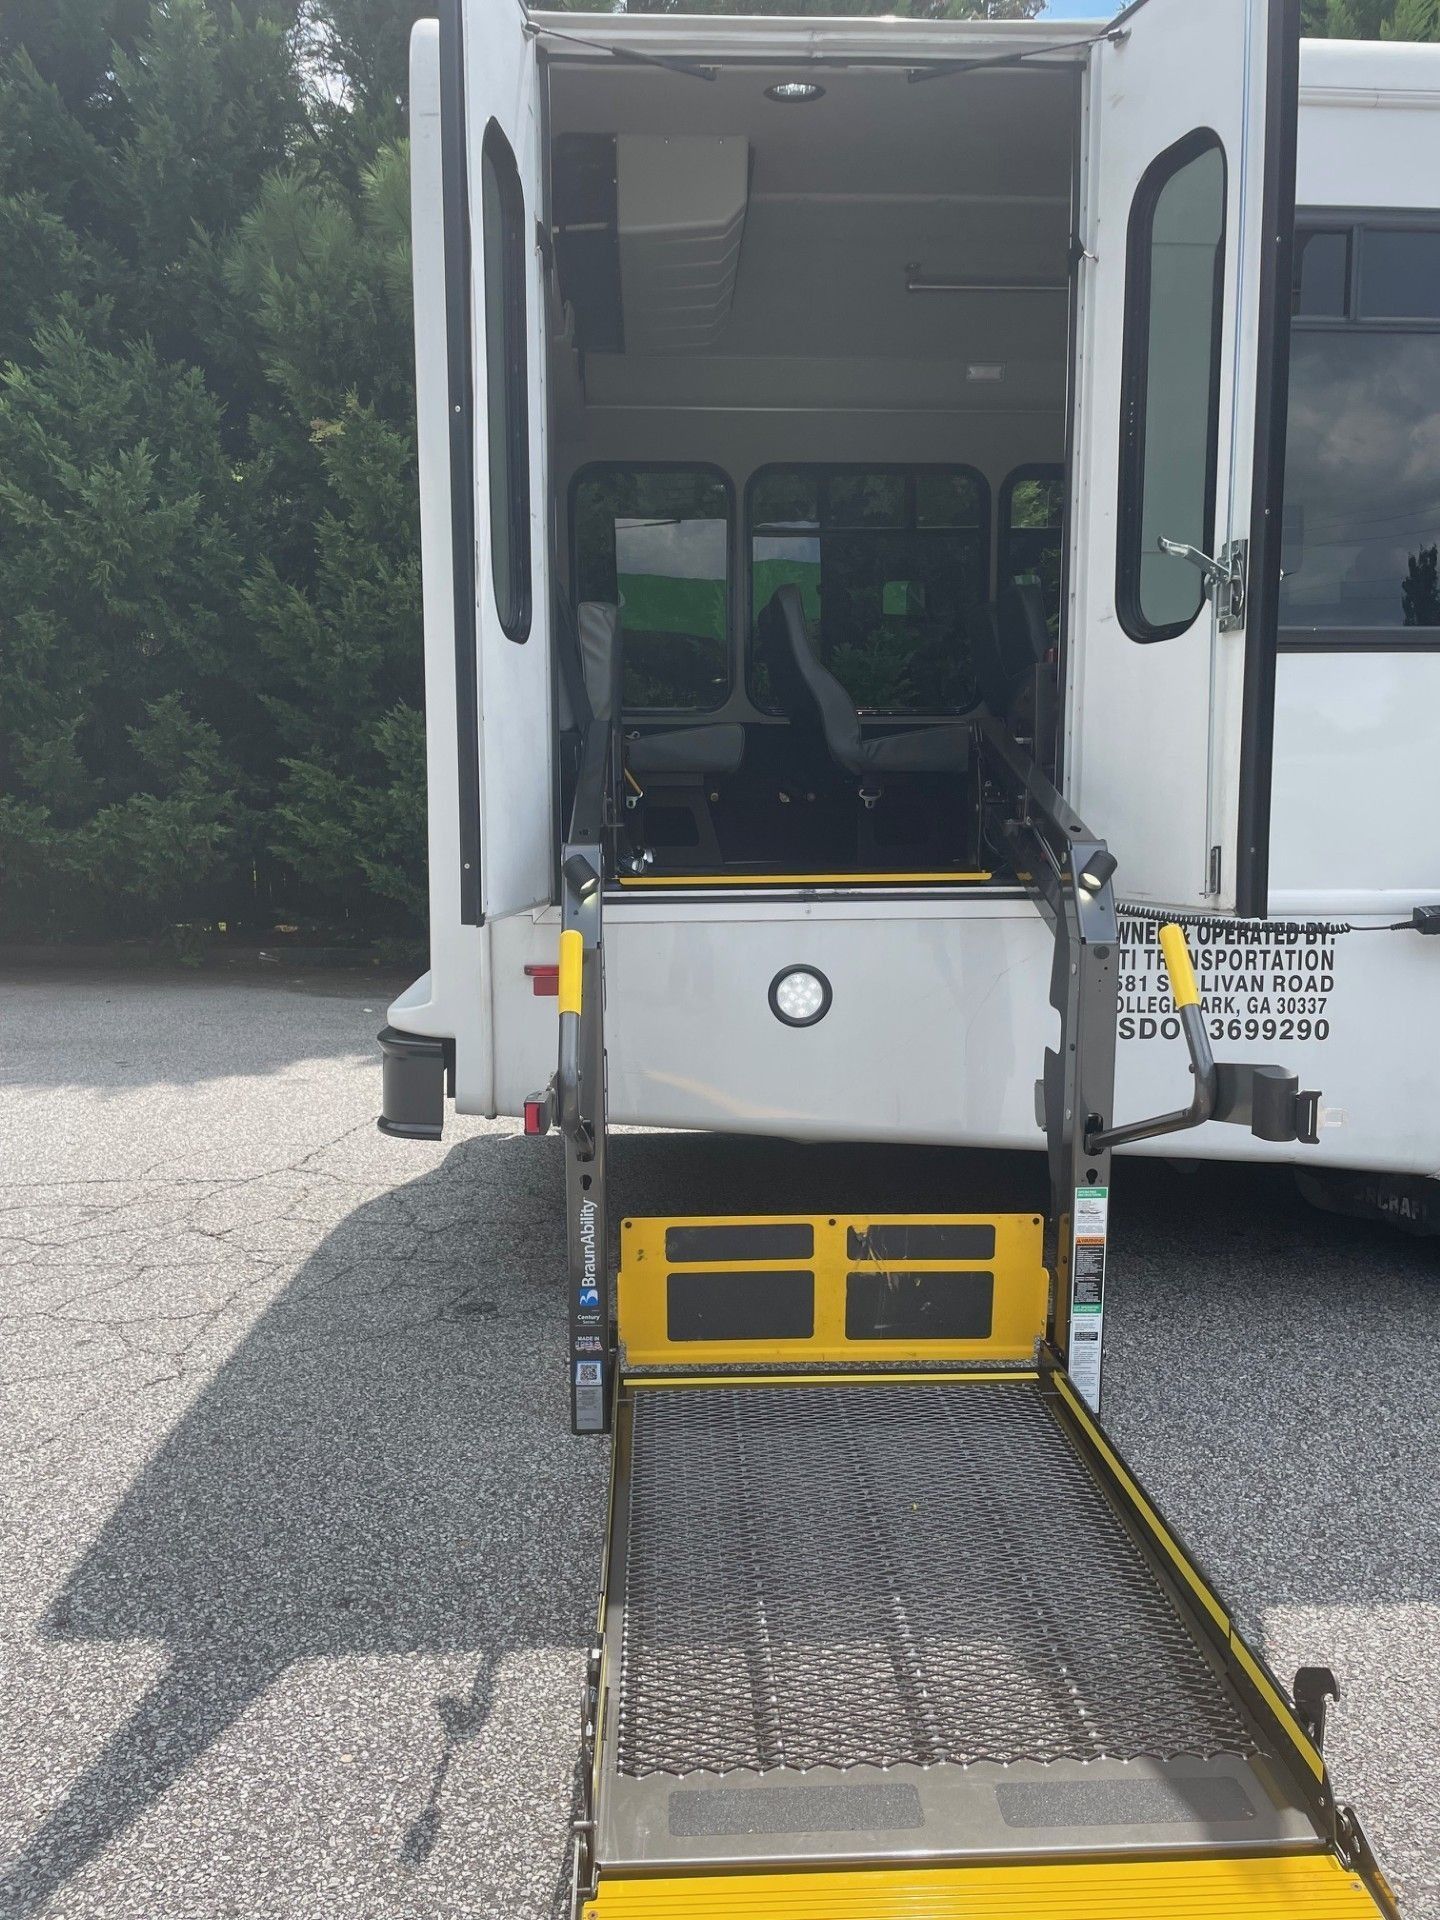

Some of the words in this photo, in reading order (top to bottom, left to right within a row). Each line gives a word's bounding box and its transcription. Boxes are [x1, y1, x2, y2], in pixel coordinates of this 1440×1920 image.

[1118, 922, 1169, 945] WNE
[1197, 921, 1299, 945] OPERATED
[1143, 948, 1335, 971] TRNSPORTATION
[1156, 974, 1265, 993] SLIVAN
[1272, 974, 1335, 993] ROAD
[1199, 996, 1241, 1017] ARK,
[1246, 996, 1272, 1015] GA
[1276, 997, 1328, 1015] 30337
[1118, 1017, 1181, 1041] SDO
[1209, 1018, 1331, 1041] 3699290
[579, 1199, 598, 1288] BraunAbility
